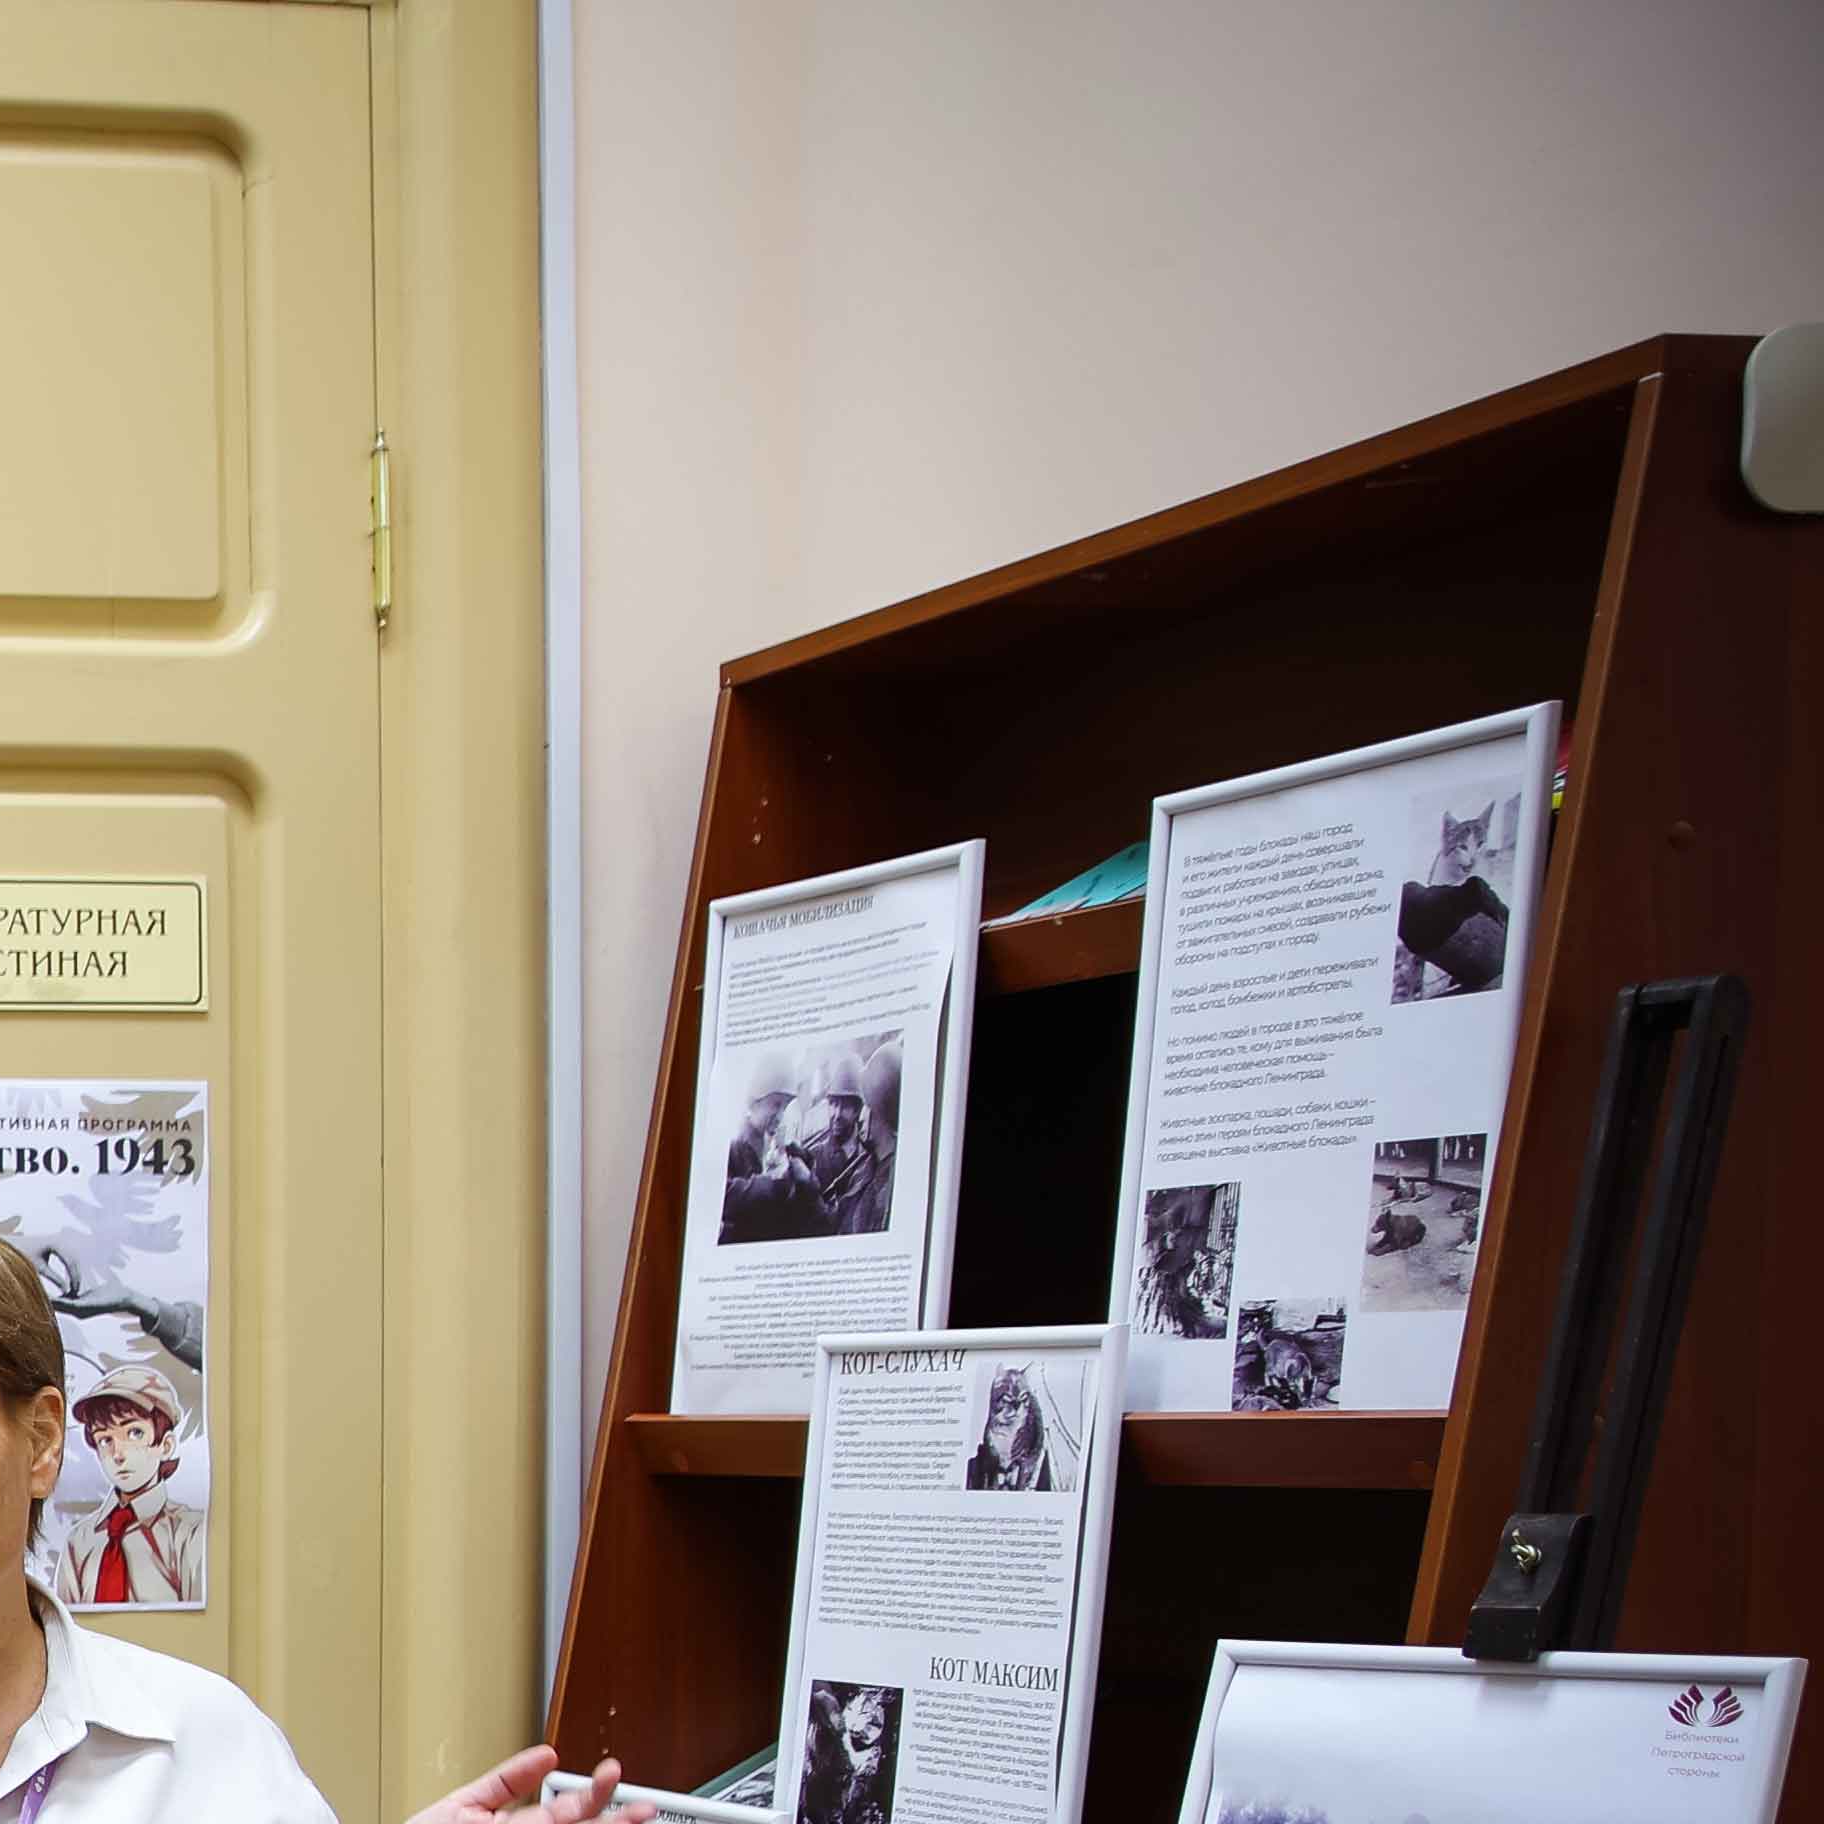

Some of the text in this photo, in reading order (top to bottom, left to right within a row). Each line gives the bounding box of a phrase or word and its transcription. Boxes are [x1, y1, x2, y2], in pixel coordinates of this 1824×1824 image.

[1323, 824, 1353, 836] город
[1349, 904, 1391, 920] рубежи
[1286, 968, 1310, 981] дети
[1312, 957, 1379, 976] переживали
[1355, 1026, 1383, 1039] была
[79, 1118, 191, 1132] ПРОГРАММА
[95, 1138, 196, 1176] 1943
[841, 1349, 967, 1375] КОТ-СЛУХАЧ
[930, 1657, 1058, 1691] КОТ МАКСИМ
